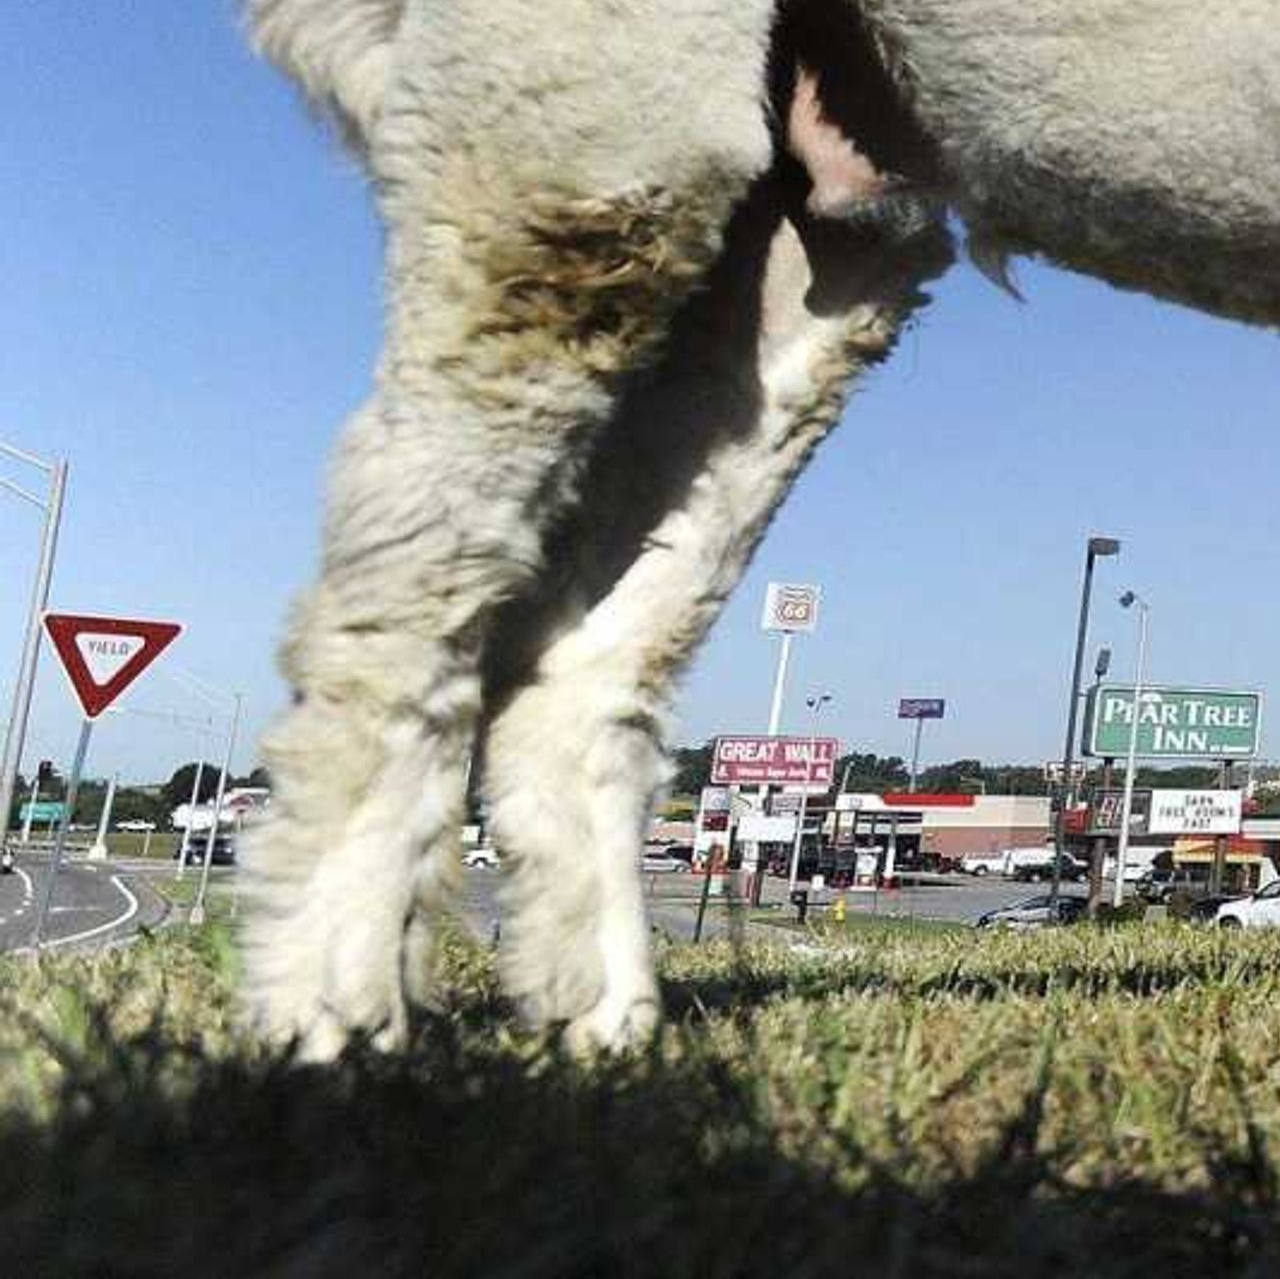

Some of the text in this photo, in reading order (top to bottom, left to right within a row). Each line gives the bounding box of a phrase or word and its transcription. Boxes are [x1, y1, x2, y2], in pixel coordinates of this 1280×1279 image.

[782, 601, 808, 619] 66
[88, 640, 129, 656] YIELD
[1183, 700, 1250, 727] TREE
[1152, 726, 1208, 751] INN
[720, 741, 831, 763] GREAT WALL
